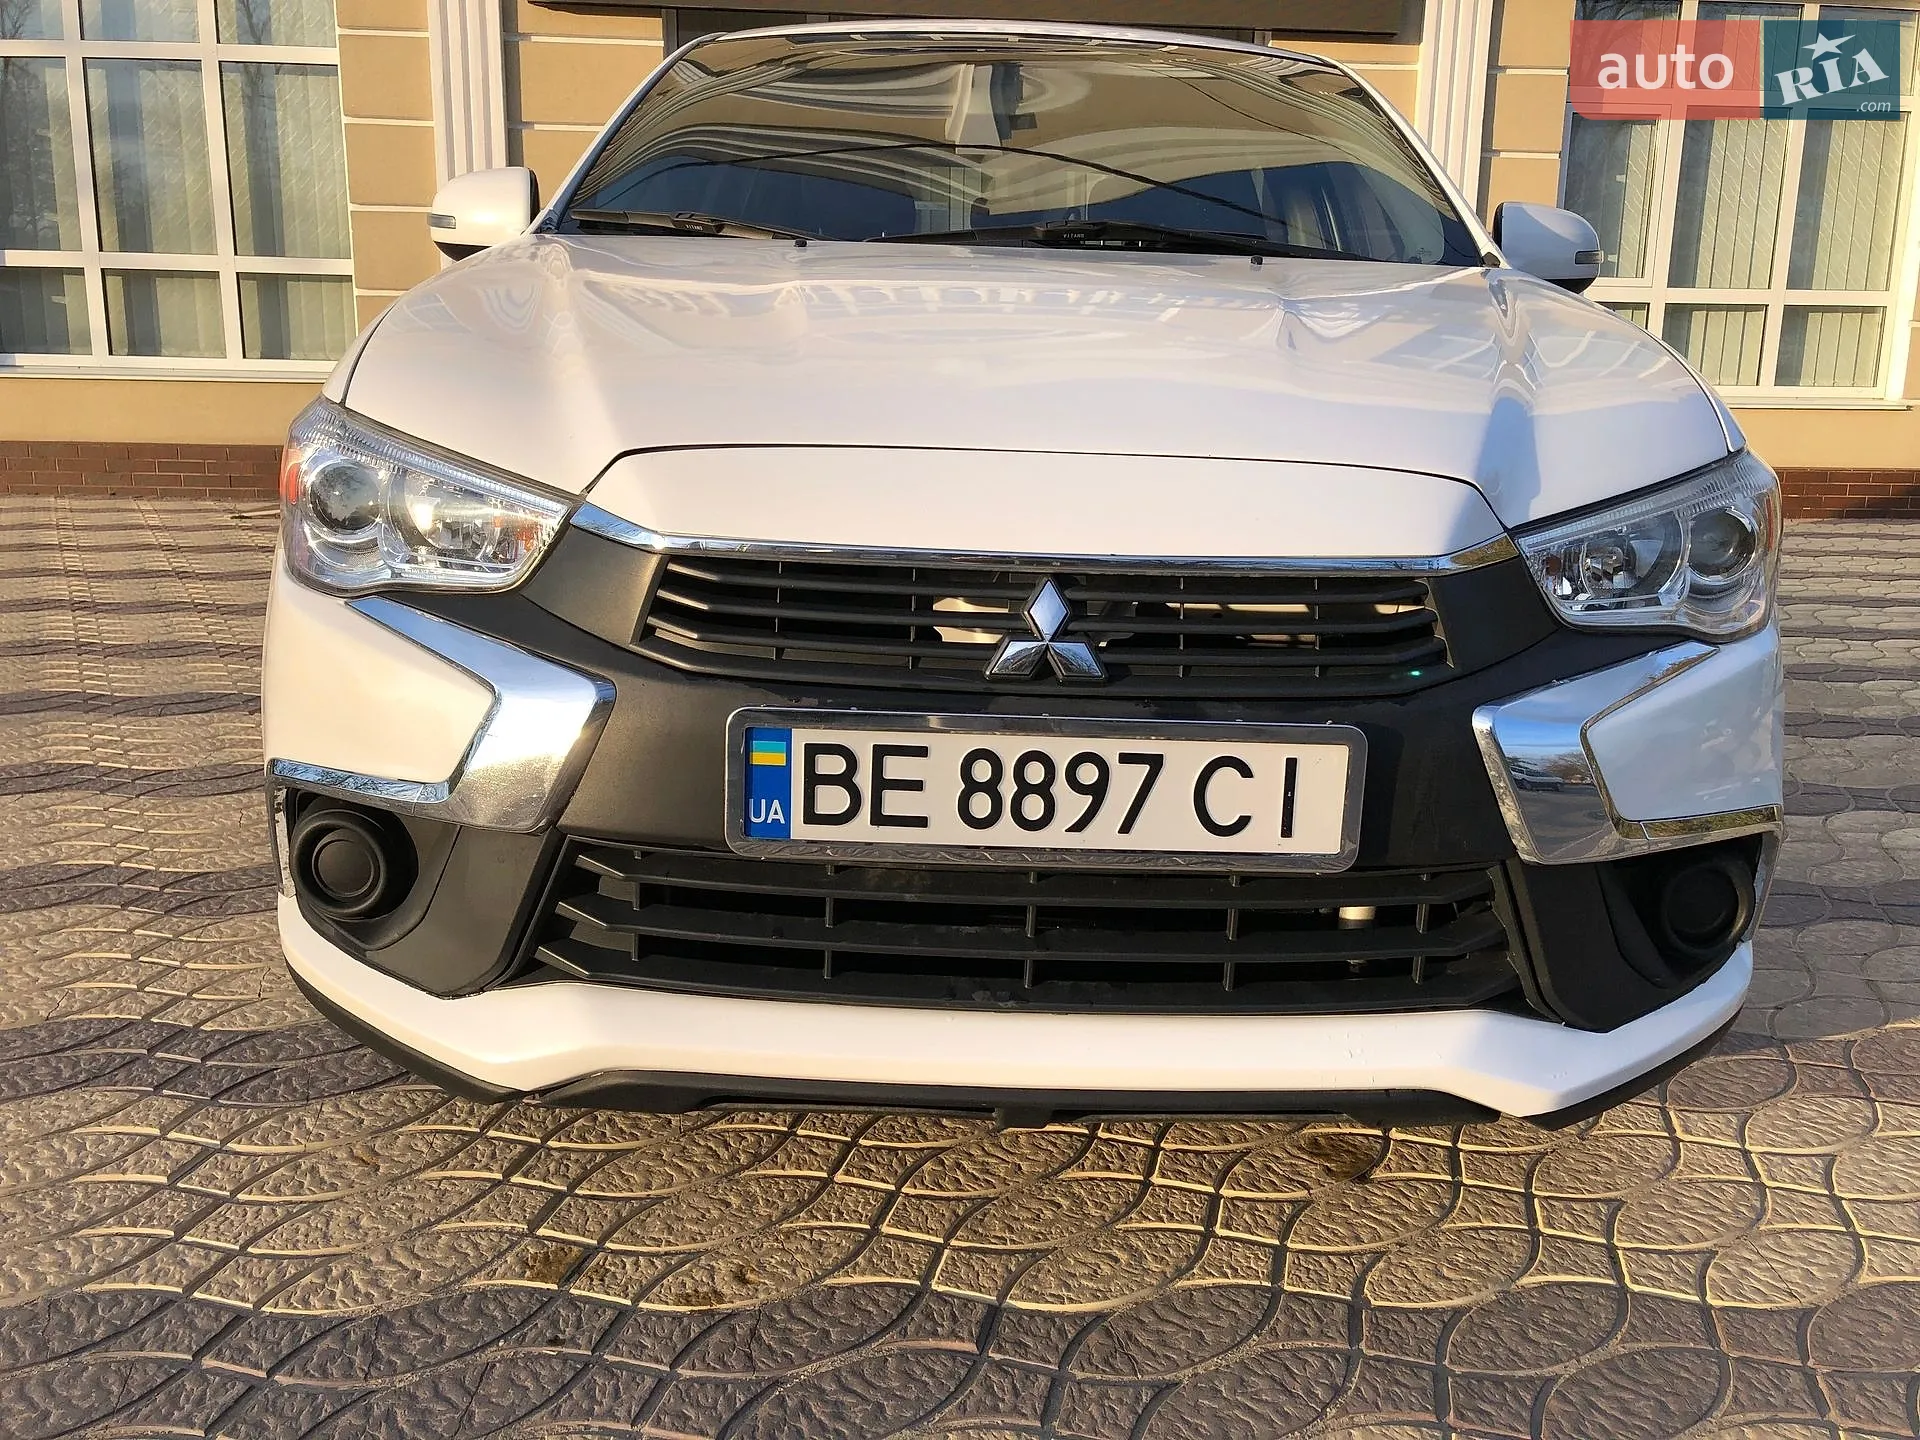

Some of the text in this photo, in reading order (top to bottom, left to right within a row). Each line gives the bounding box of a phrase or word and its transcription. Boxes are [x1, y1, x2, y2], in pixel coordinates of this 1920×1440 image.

[749, 798, 786, 824] UA
[802, 742, 1299, 839] BE 8897 CI
